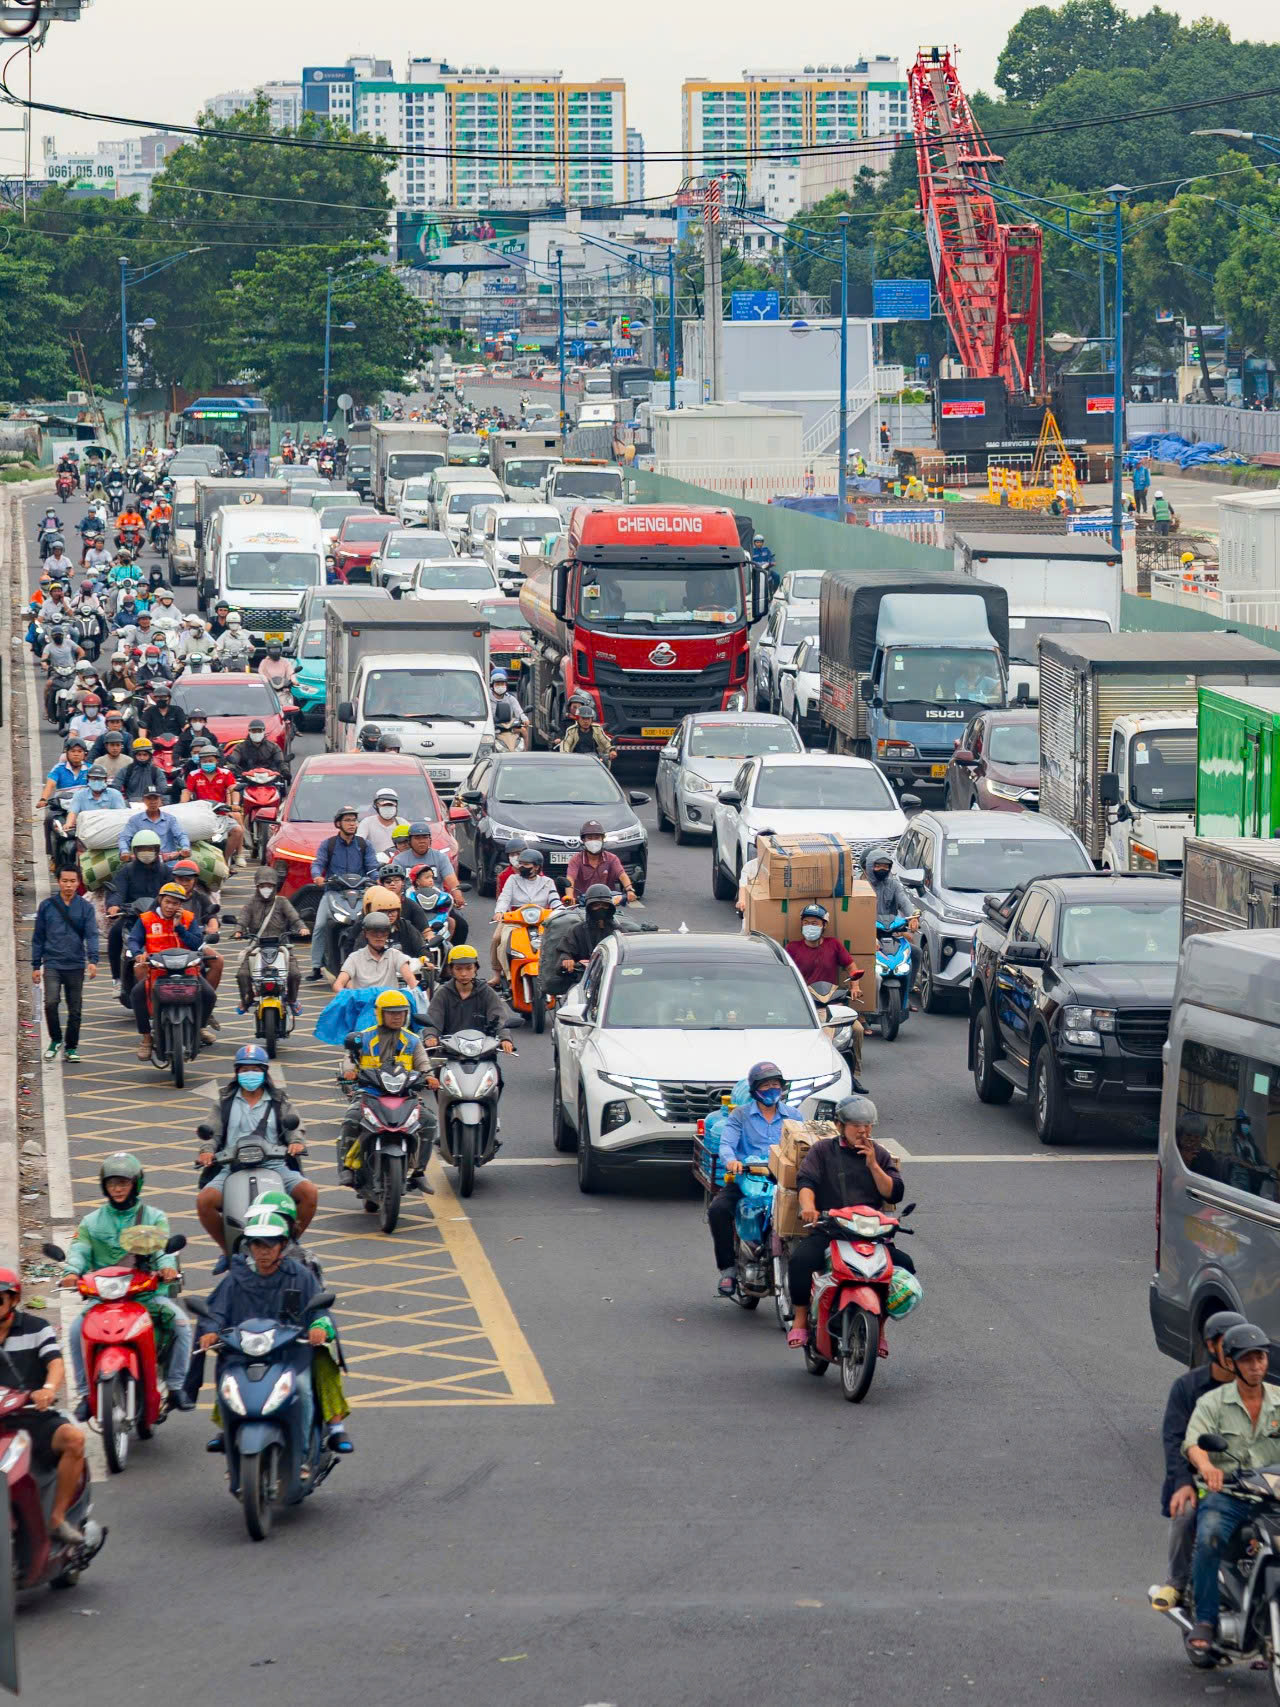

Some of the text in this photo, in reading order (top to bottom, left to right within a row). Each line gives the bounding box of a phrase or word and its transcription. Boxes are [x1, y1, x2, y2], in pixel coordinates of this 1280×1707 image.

[48, 165, 114, 178] 0961.015.016
[617, 516, 703, 533] CHENGLONG
[925, 710, 965, 718] ISUZU
[552, 854, 575, 863] 51H-
